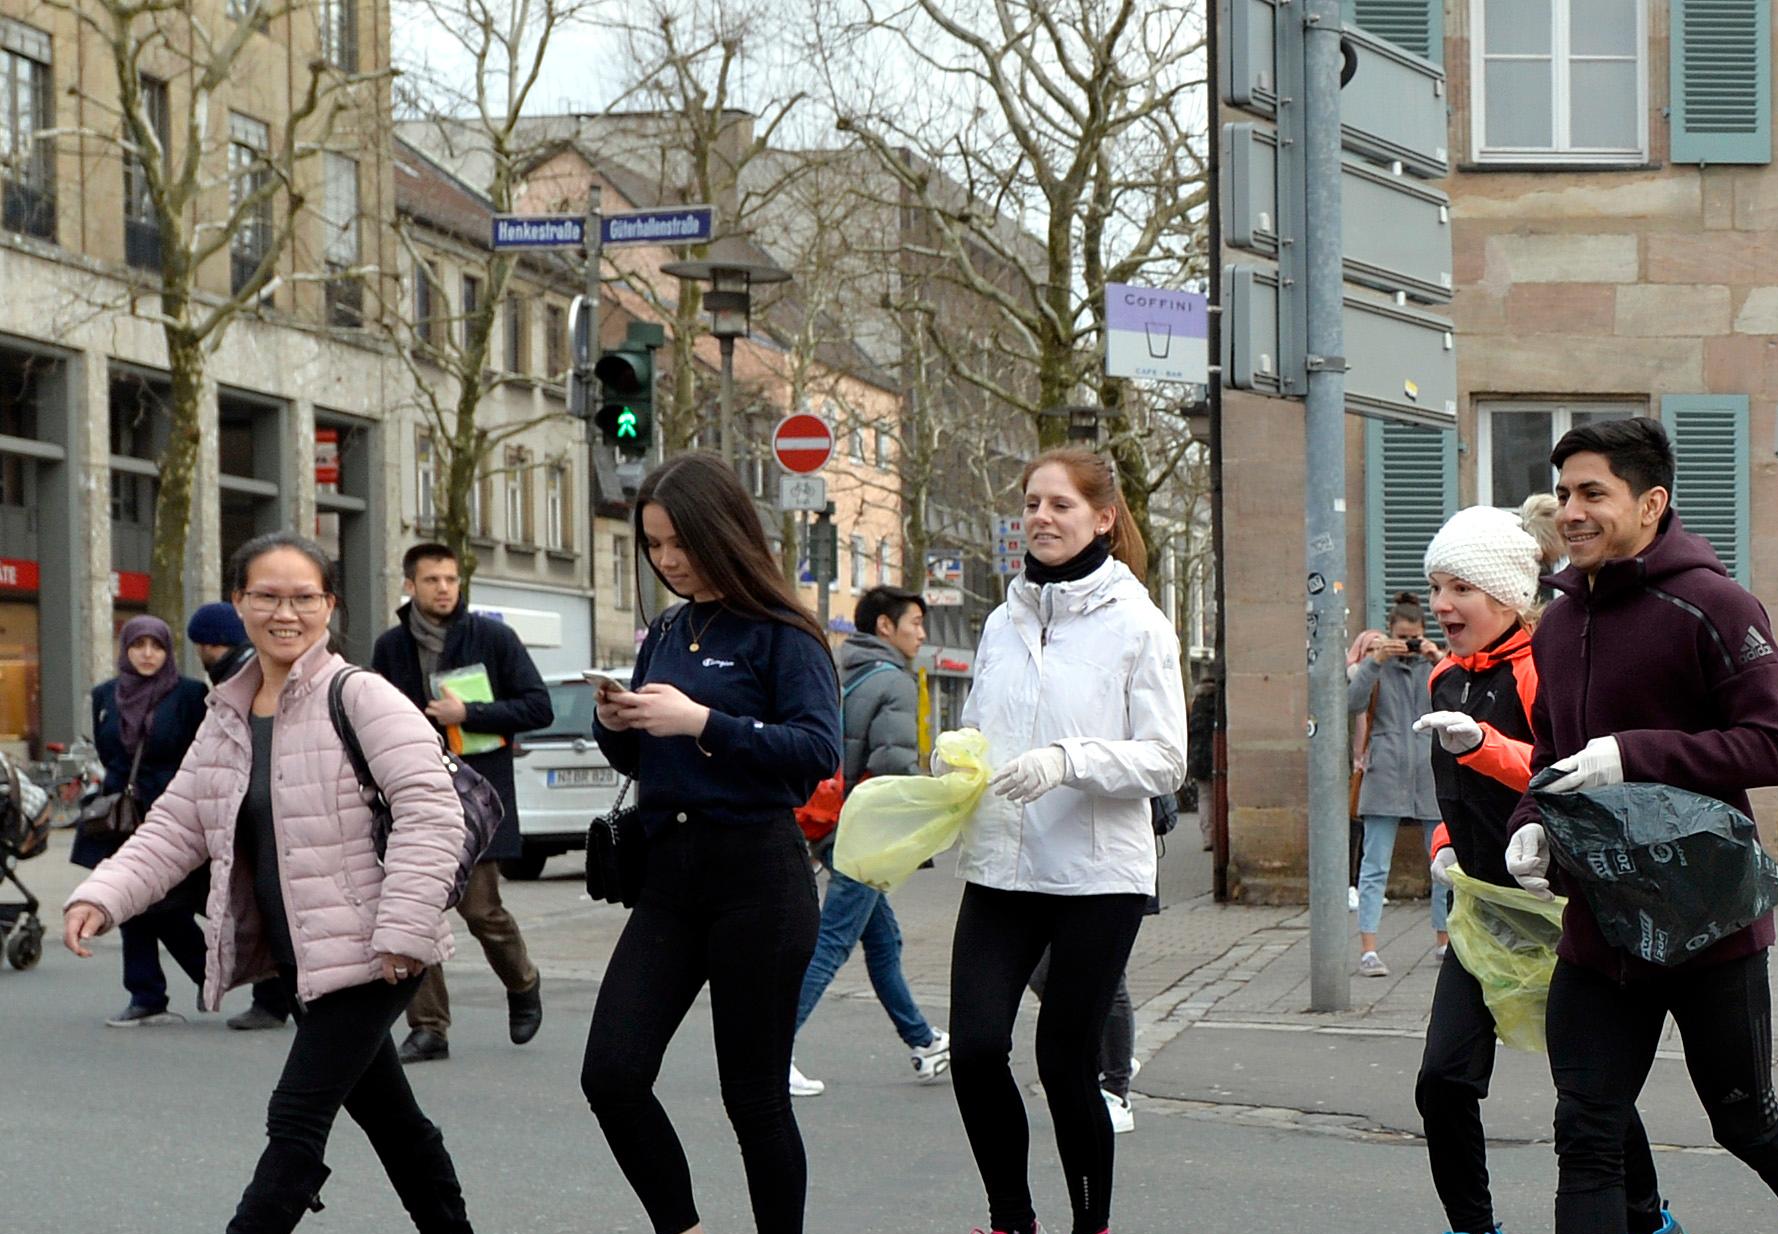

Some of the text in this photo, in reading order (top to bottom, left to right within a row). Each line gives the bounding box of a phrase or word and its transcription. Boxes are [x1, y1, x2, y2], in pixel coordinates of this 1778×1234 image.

[498, 220, 581, 241] Henkestraße
[609, 214, 700, 240] Güterhallenstraße
[1124, 293, 1192, 313] COFFINI
[1739, 643, 1774, 663] adidas
